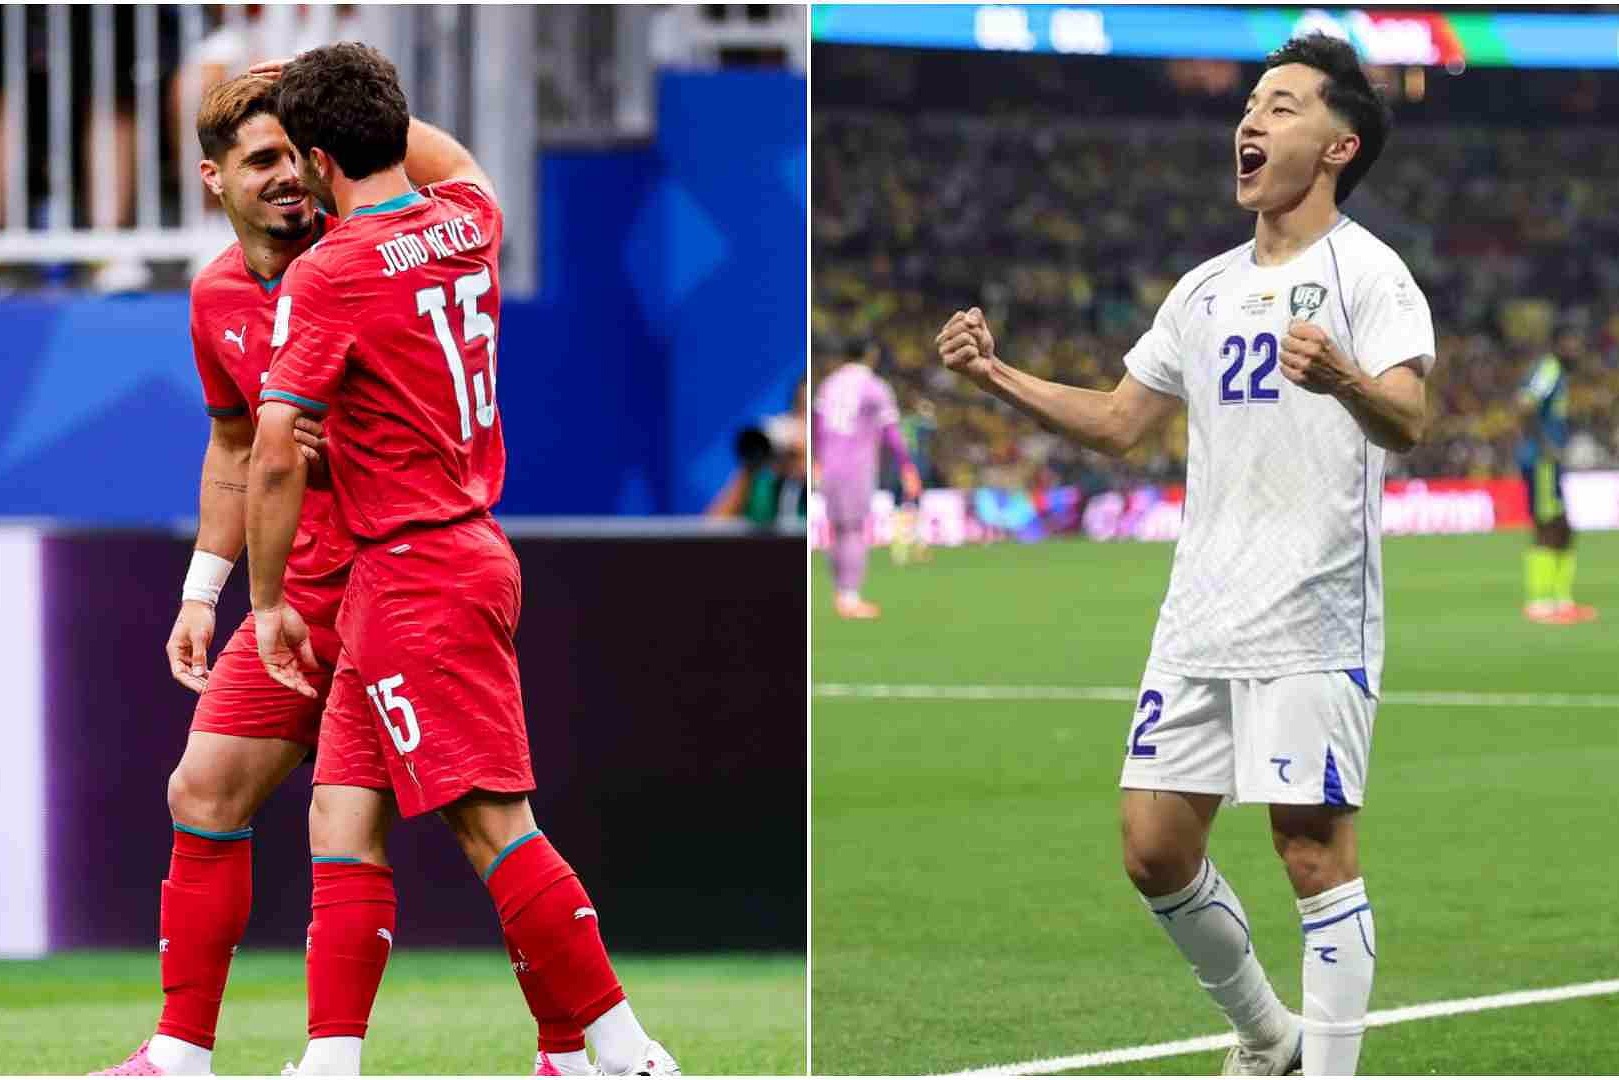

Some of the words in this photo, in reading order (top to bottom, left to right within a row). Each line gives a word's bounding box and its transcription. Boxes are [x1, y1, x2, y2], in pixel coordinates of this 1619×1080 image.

[376, 231, 429, 277] JOÃO
[422, 213, 482, 260] NEVES
[1292, 287, 1321, 306] UFA
[415, 264, 497, 442] 15
[1218, 332, 1280, 405] 22
[365, 672, 422, 756] 15
[1126, 688, 1164, 759] 2
